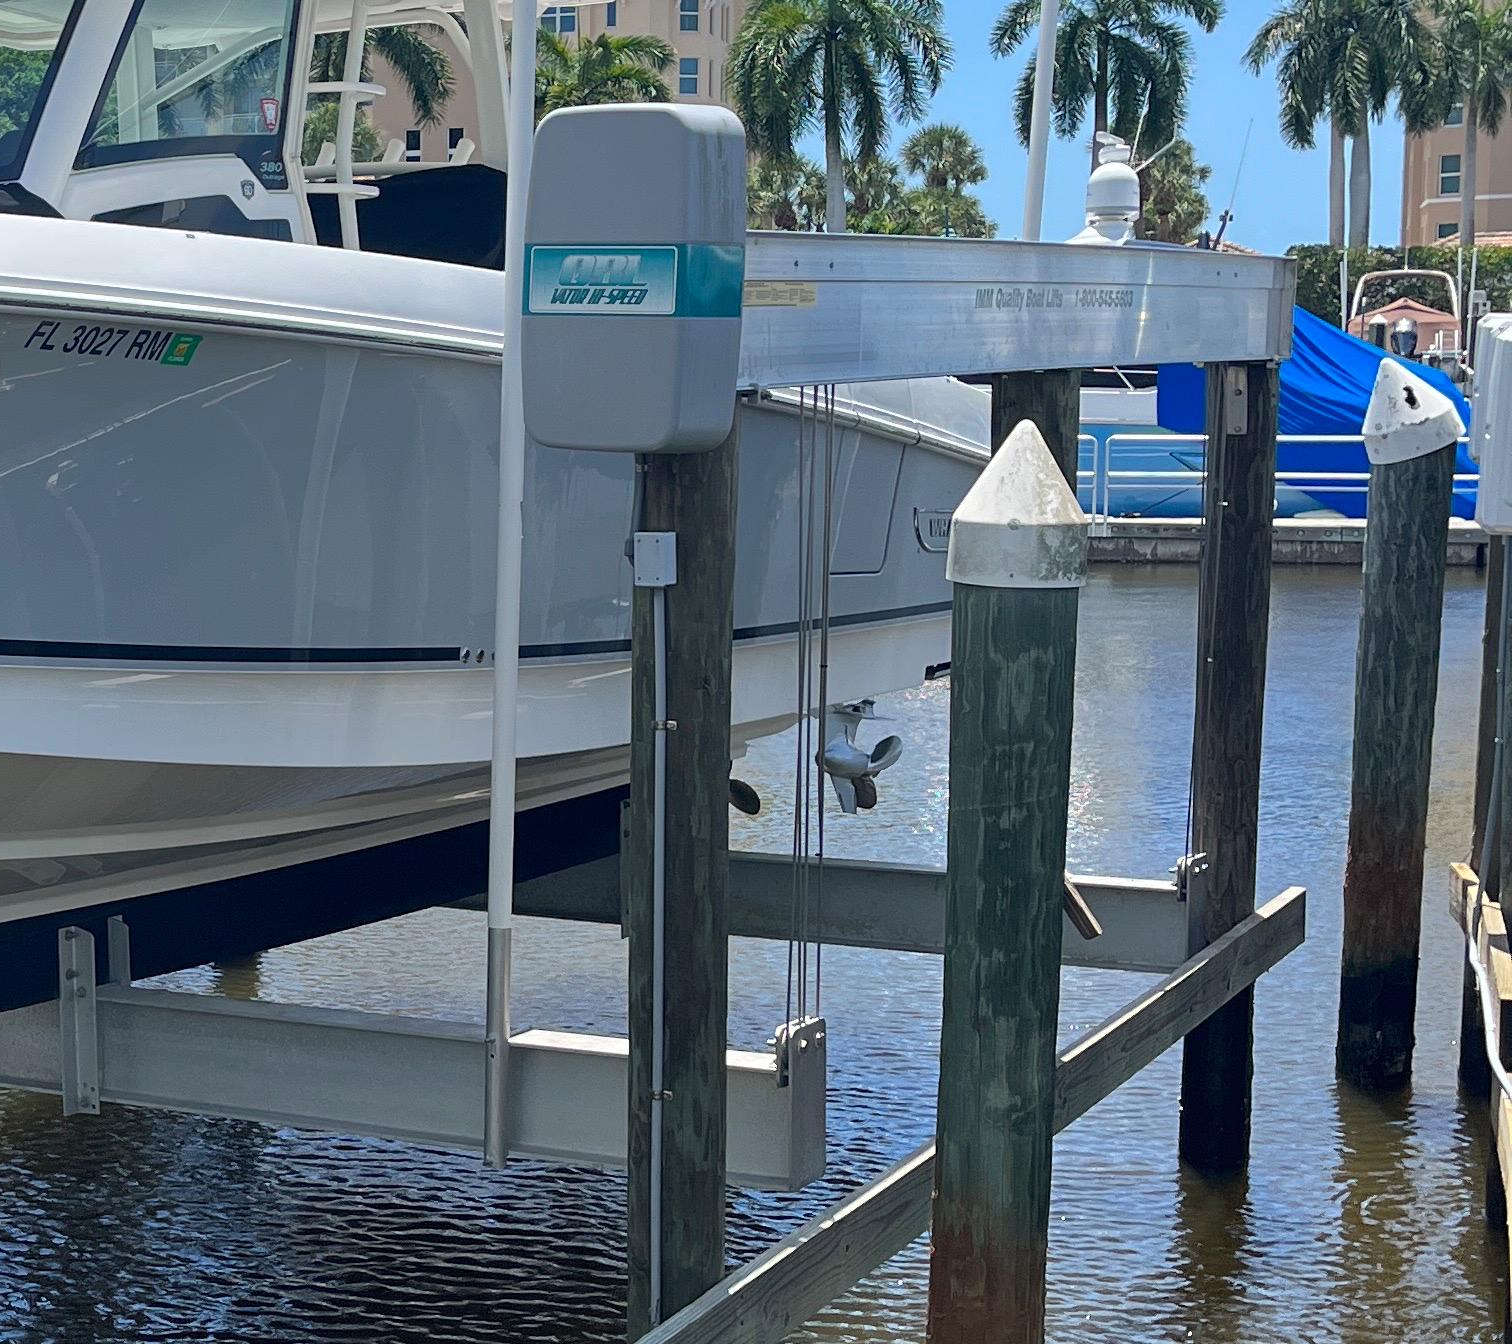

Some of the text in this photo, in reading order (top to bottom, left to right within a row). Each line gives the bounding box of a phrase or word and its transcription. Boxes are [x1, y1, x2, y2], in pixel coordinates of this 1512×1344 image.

[260, 161, 283, 173] 380
[587, 288, 649, 305] HI-SPEED
[996, 288, 1025, 312] Quality
[1026, 288, 1045, 308] Boat
[1046, 288, 1064, 308] Lifts
[24, 320, 173, 361] FL 3027 RM
